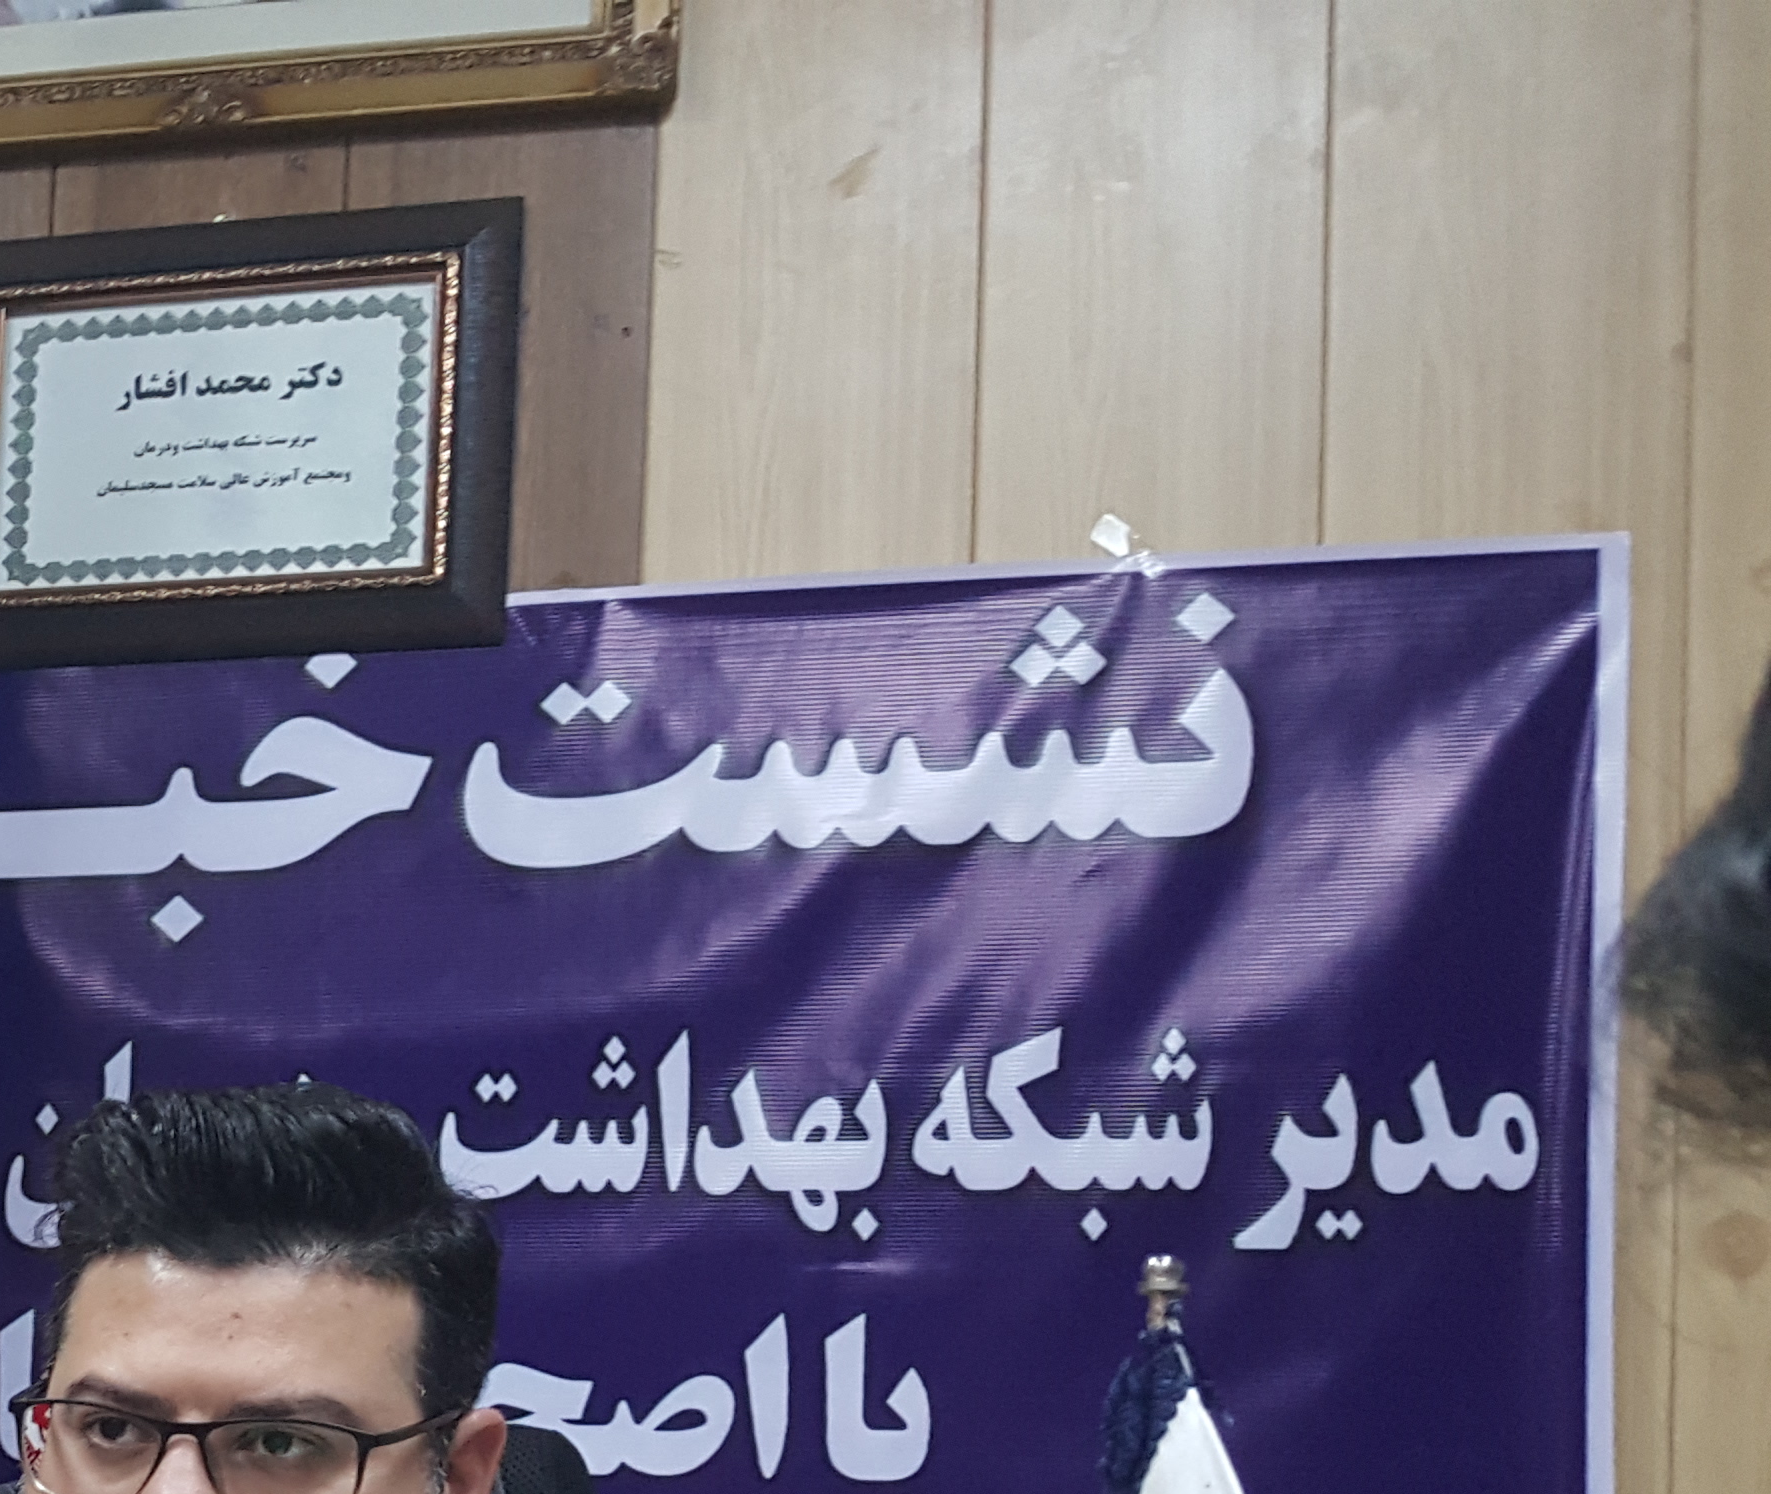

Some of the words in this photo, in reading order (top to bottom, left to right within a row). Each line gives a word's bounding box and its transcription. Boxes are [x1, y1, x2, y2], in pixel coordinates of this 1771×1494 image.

[115, 369, 190, 412] افشار
[195, 372, 272, 399] محمد
[279, 361, 344, 401] دکتر
[463, 592, 1256, 869] نشست
[439, 1028, 888, 1242] بهداشت
[911, 1026, 1214, 1242] شبکه
[1232, 1039, 1540, 1252] مدیر
[473, 1312, 790, 1481] اصح
